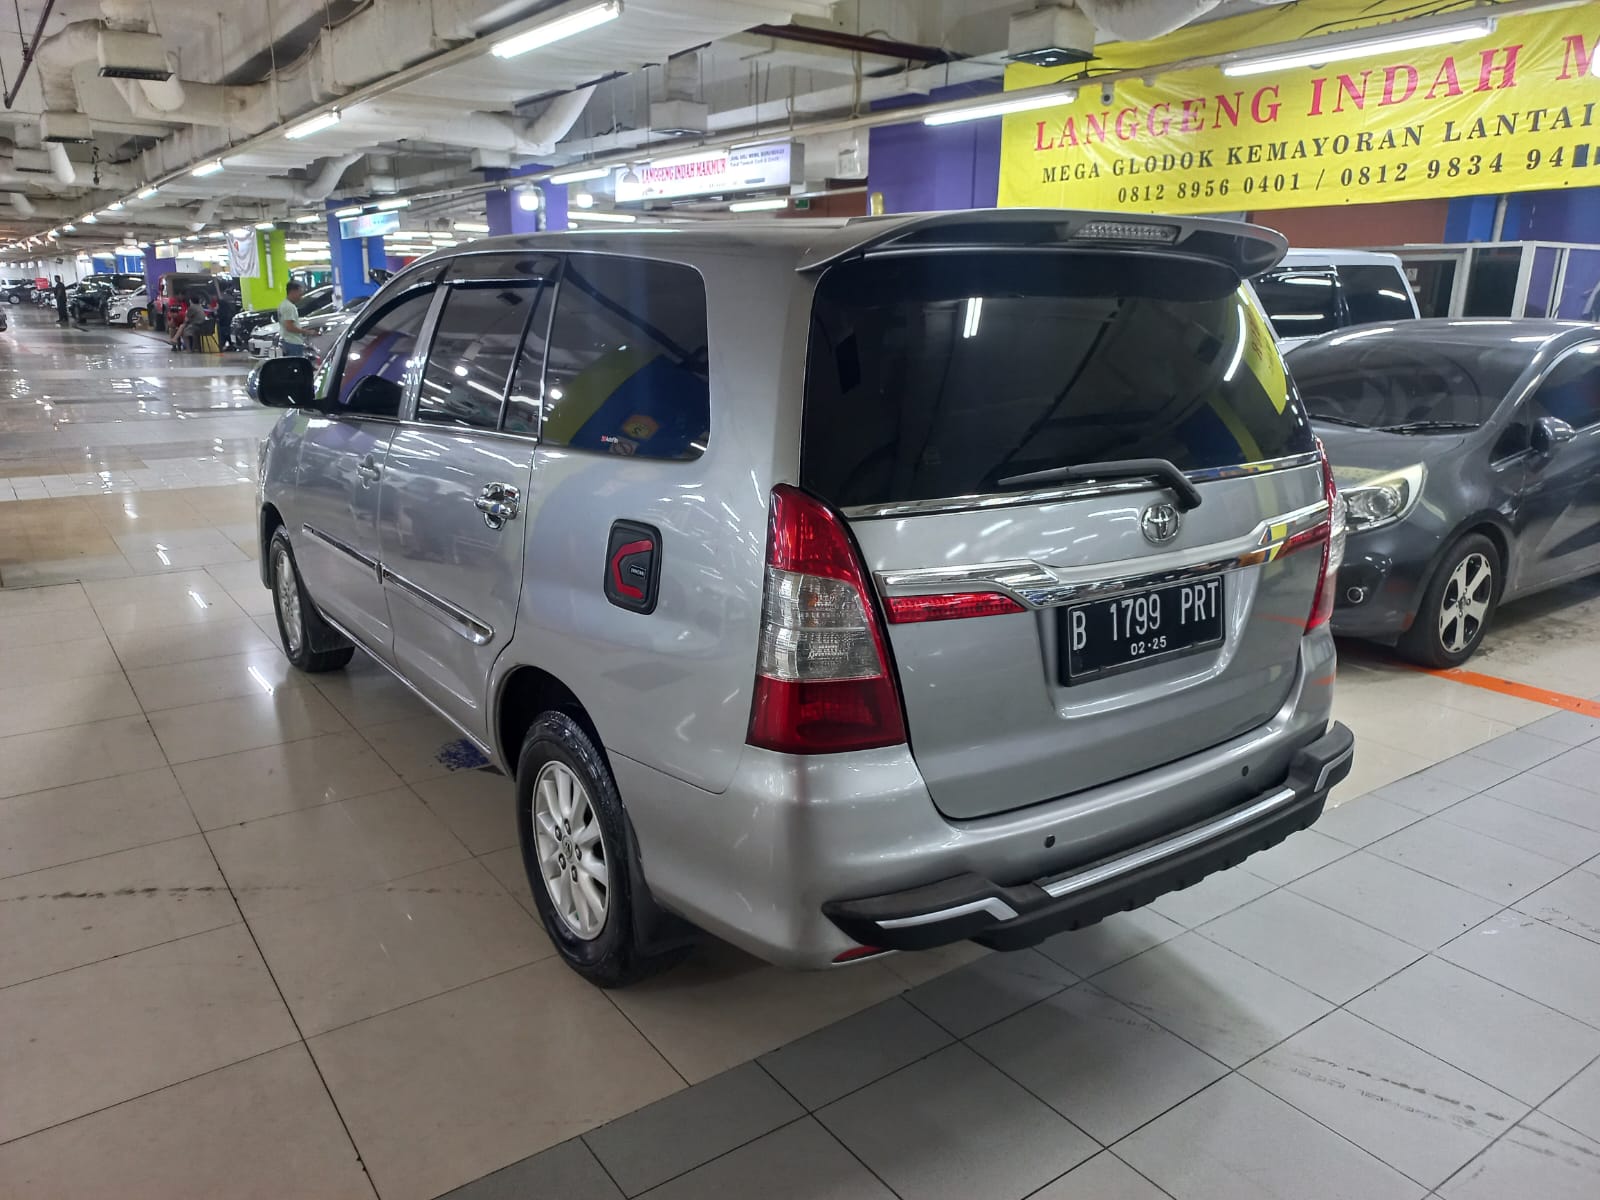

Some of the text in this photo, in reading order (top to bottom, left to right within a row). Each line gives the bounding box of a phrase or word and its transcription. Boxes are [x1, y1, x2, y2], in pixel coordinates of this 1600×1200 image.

[1034, 85, 1282, 151] LANGGENG
[1307, 44, 1524, 116] INDAH
[1042, 102, 1596, 183] MEGA GLODOK KEMAYORAN LANTAI
[1118, 184, 1165, 203] 0812
[1177, 178, 1229, 199] 8956
[1243, 173, 1301, 194] 0401
[1340, 163, 1408, 187] 0812
[1426, 152, 1503, 179] 9834
[1072, 582, 1218, 650] B 1799 PRT
